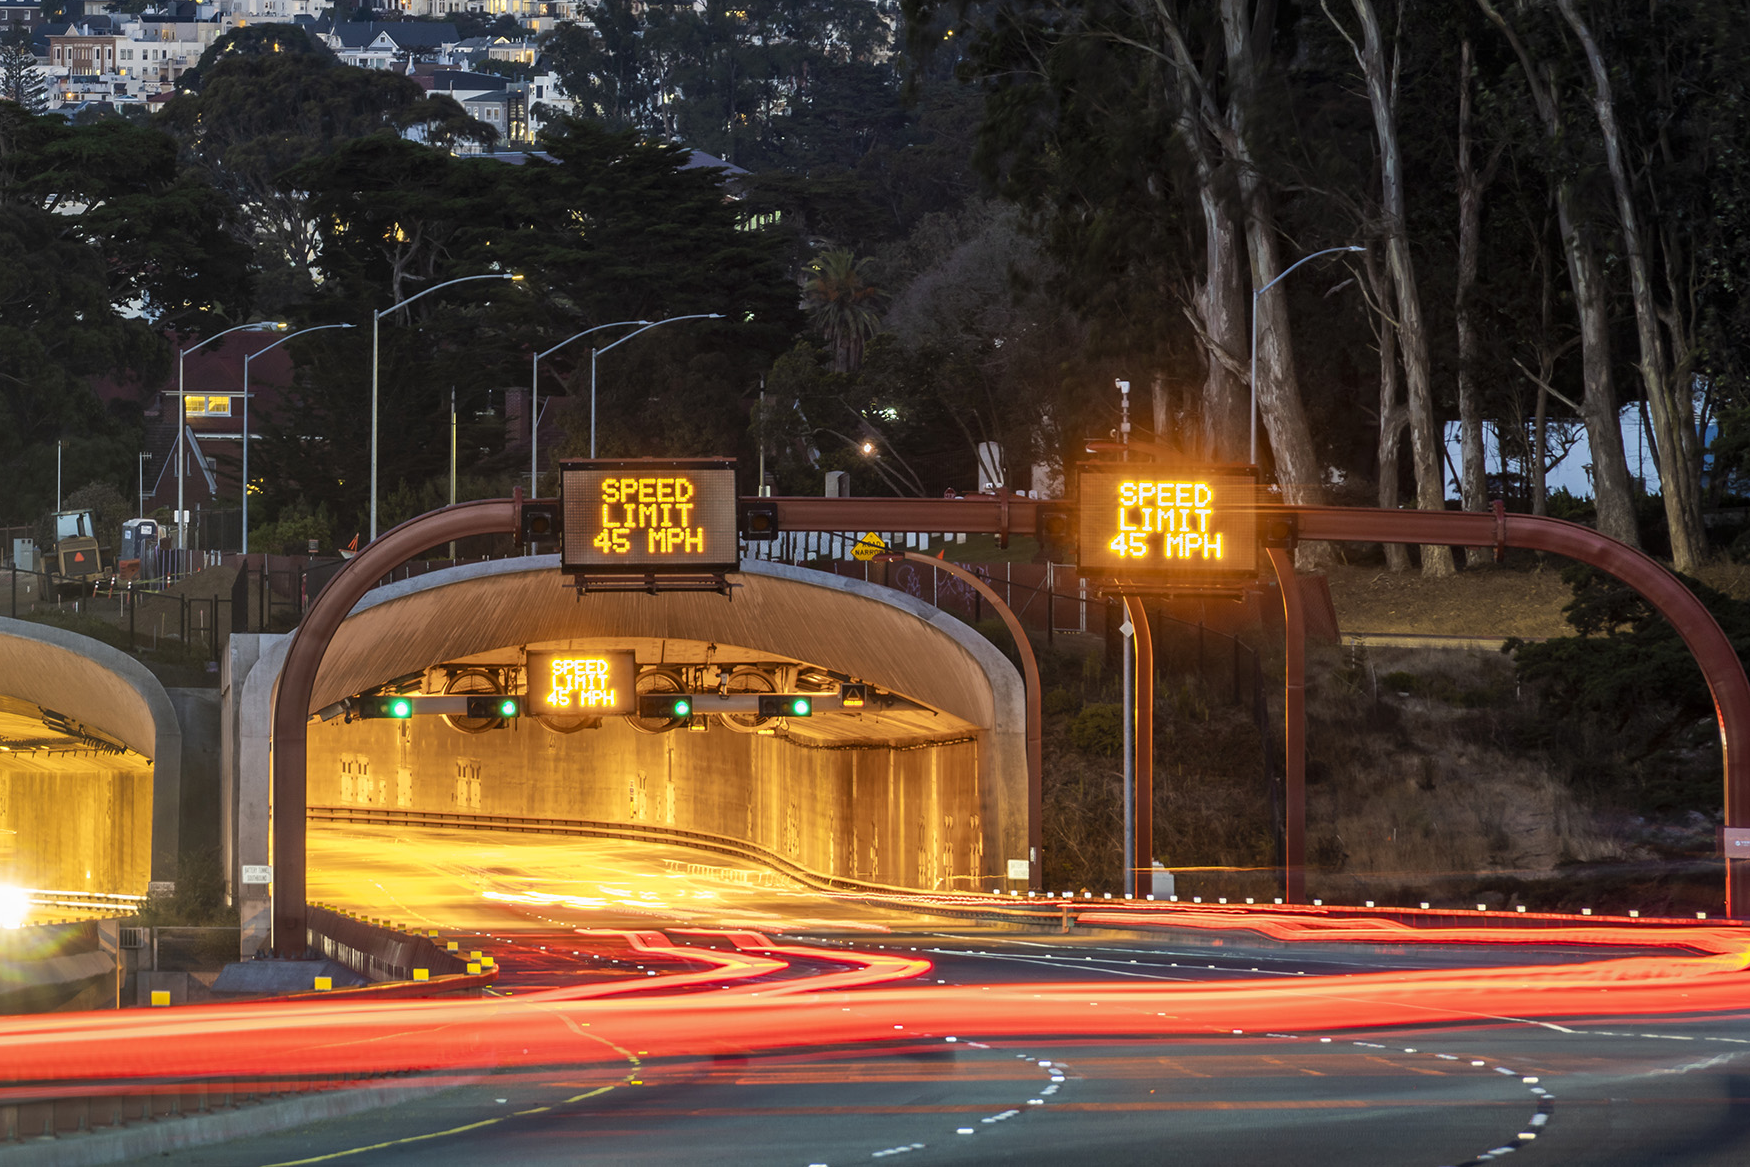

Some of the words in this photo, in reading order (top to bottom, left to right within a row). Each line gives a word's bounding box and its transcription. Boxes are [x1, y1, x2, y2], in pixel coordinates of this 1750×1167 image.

[601, 478, 694, 503] SPEED
[1119, 482, 1212, 507] SPEED
[601, 503, 694, 528] LIMIT
[1119, 507, 1212, 532] LIMIT
[593, 528, 631, 553] 45
[648, 527, 704, 553] MPH
[1110, 532, 1148, 558] 45
[1165, 532, 1223, 559] MPH
[551, 659, 608, 675] SPEED
[552, 674, 608, 690] LIMIT
[547, 690, 570, 706] 45
[580, 689, 615, 706] MPH
